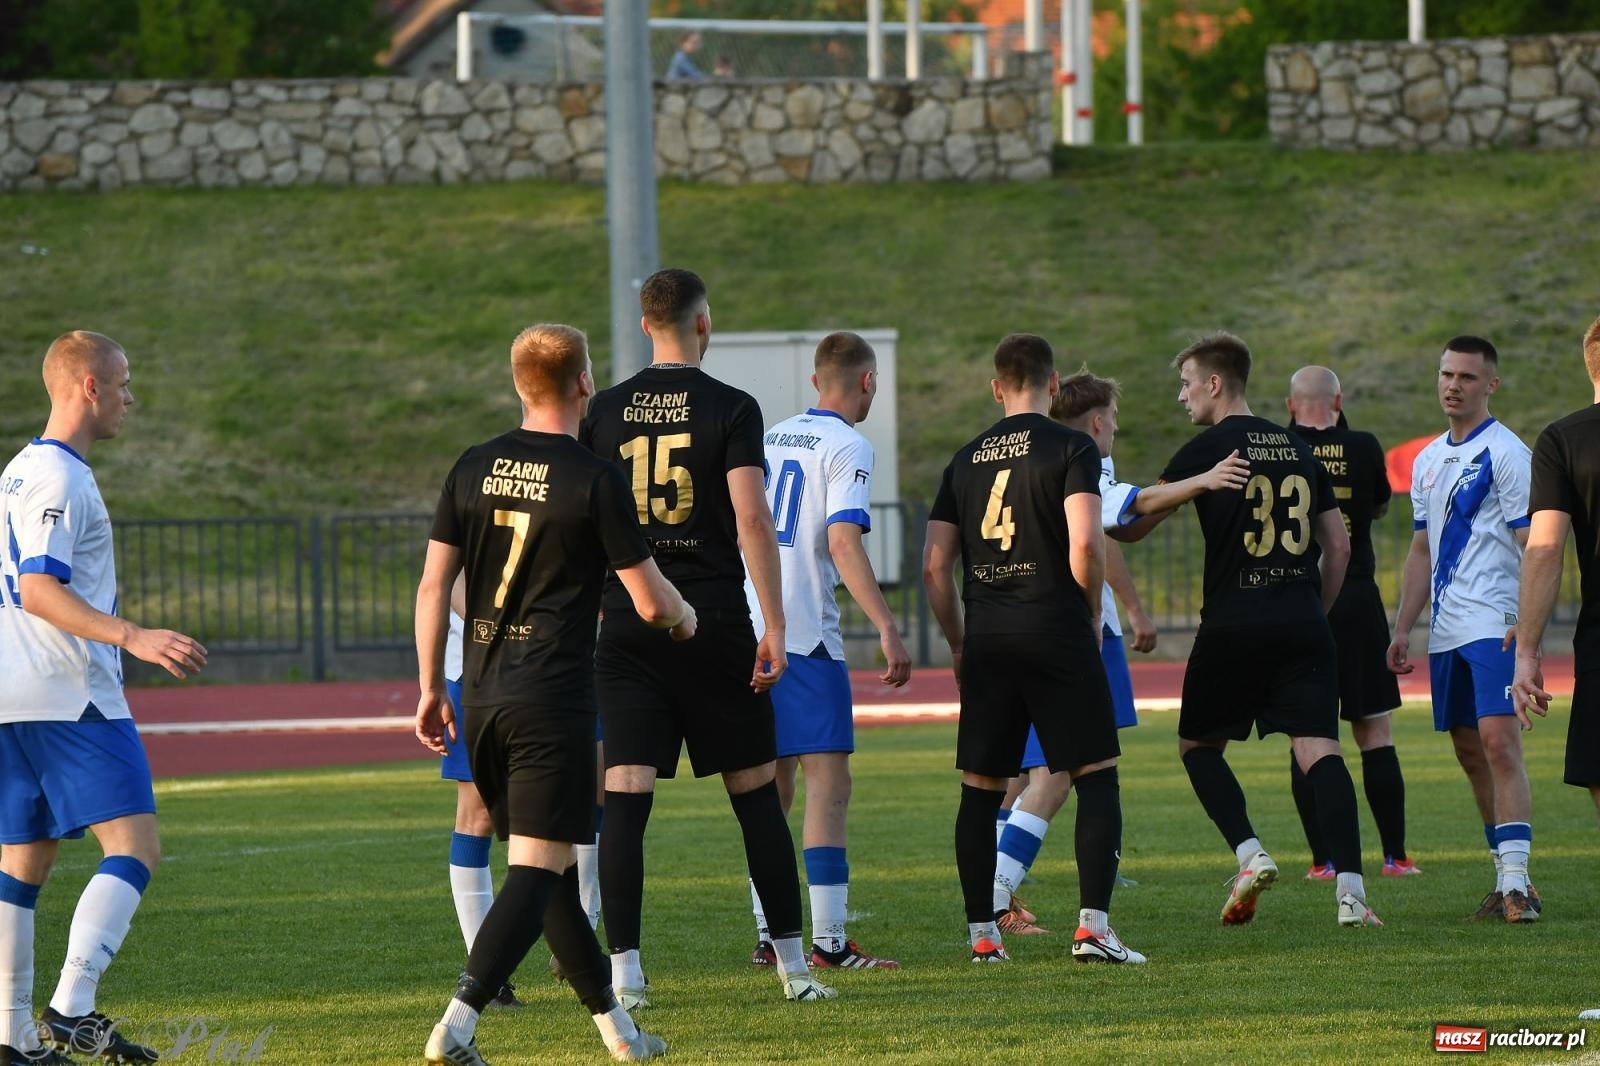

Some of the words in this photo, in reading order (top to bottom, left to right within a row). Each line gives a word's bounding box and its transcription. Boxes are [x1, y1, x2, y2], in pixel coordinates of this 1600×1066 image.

[632, 392, 688, 407] CZARNI
[624, 406, 691, 424] GORZYCE
[777, 432, 821, 451] RACIBÓRZ
[981, 430, 1031, 449] CZARNI
[1247, 432, 1290, 445] CZARNI
[972, 441, 1031, 464] GORZYCE
[1247, 446, 1299, 461] GORZYCE
[1309, 444, 1344, 459] ARNI
[492, 458, 549, 482] CZARNI
[619, 433, 694, 525] 15
[482, 476, 550, 502] GORZYCE
[764, 458, 806, 547] 0
[981, 469, 1015, 551] 4
[1243, 474, 1311, 558] 33
[494, 509, 531, 609] 7
[996, 562, 1037, 574] CLINIC
